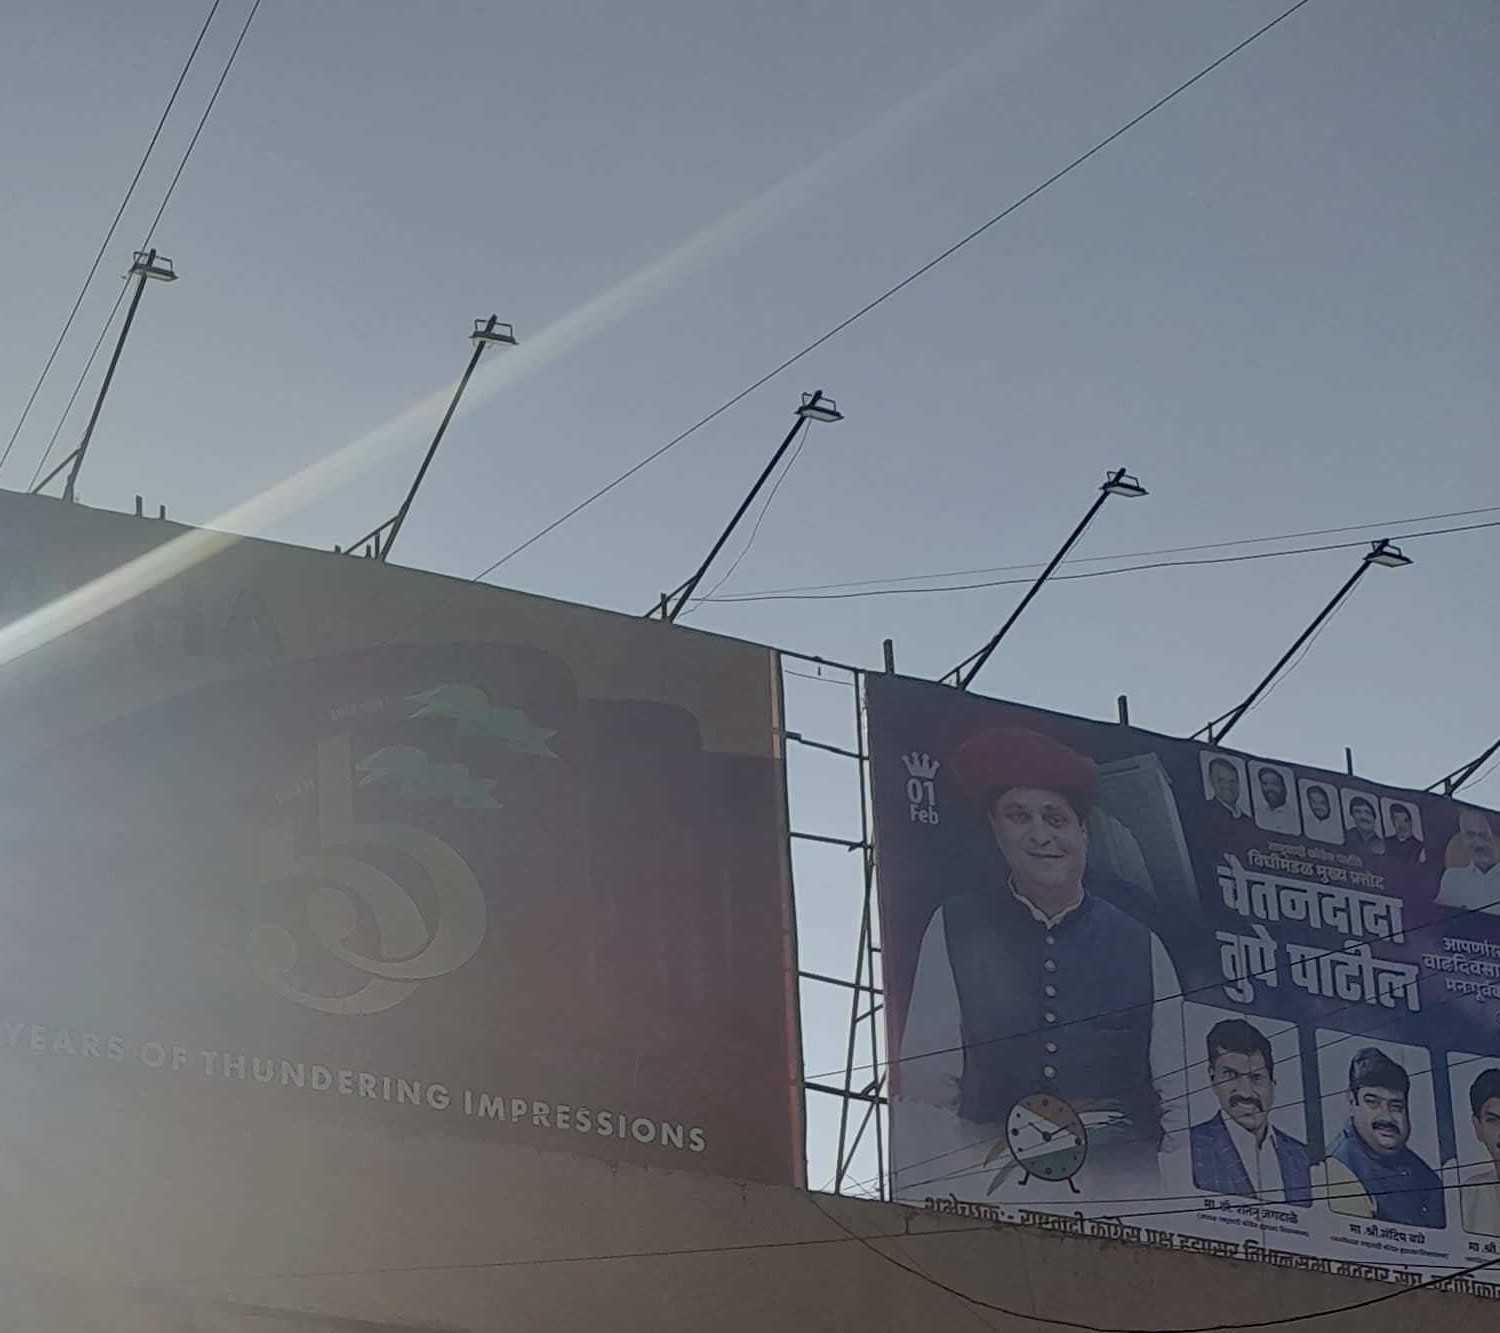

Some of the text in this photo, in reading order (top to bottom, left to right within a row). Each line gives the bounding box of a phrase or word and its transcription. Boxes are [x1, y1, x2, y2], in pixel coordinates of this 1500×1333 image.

[907, 777, 936, 806] 01
[910, 803, 940, 825] Feb
[1217, 853, 1405, 943] चेतनदादा
[1215, 924, 1420, 1011] तुपे पाटील
[4, 1021, 708, 1154] YEARS OF THUNDERING IMPRESSIONS
